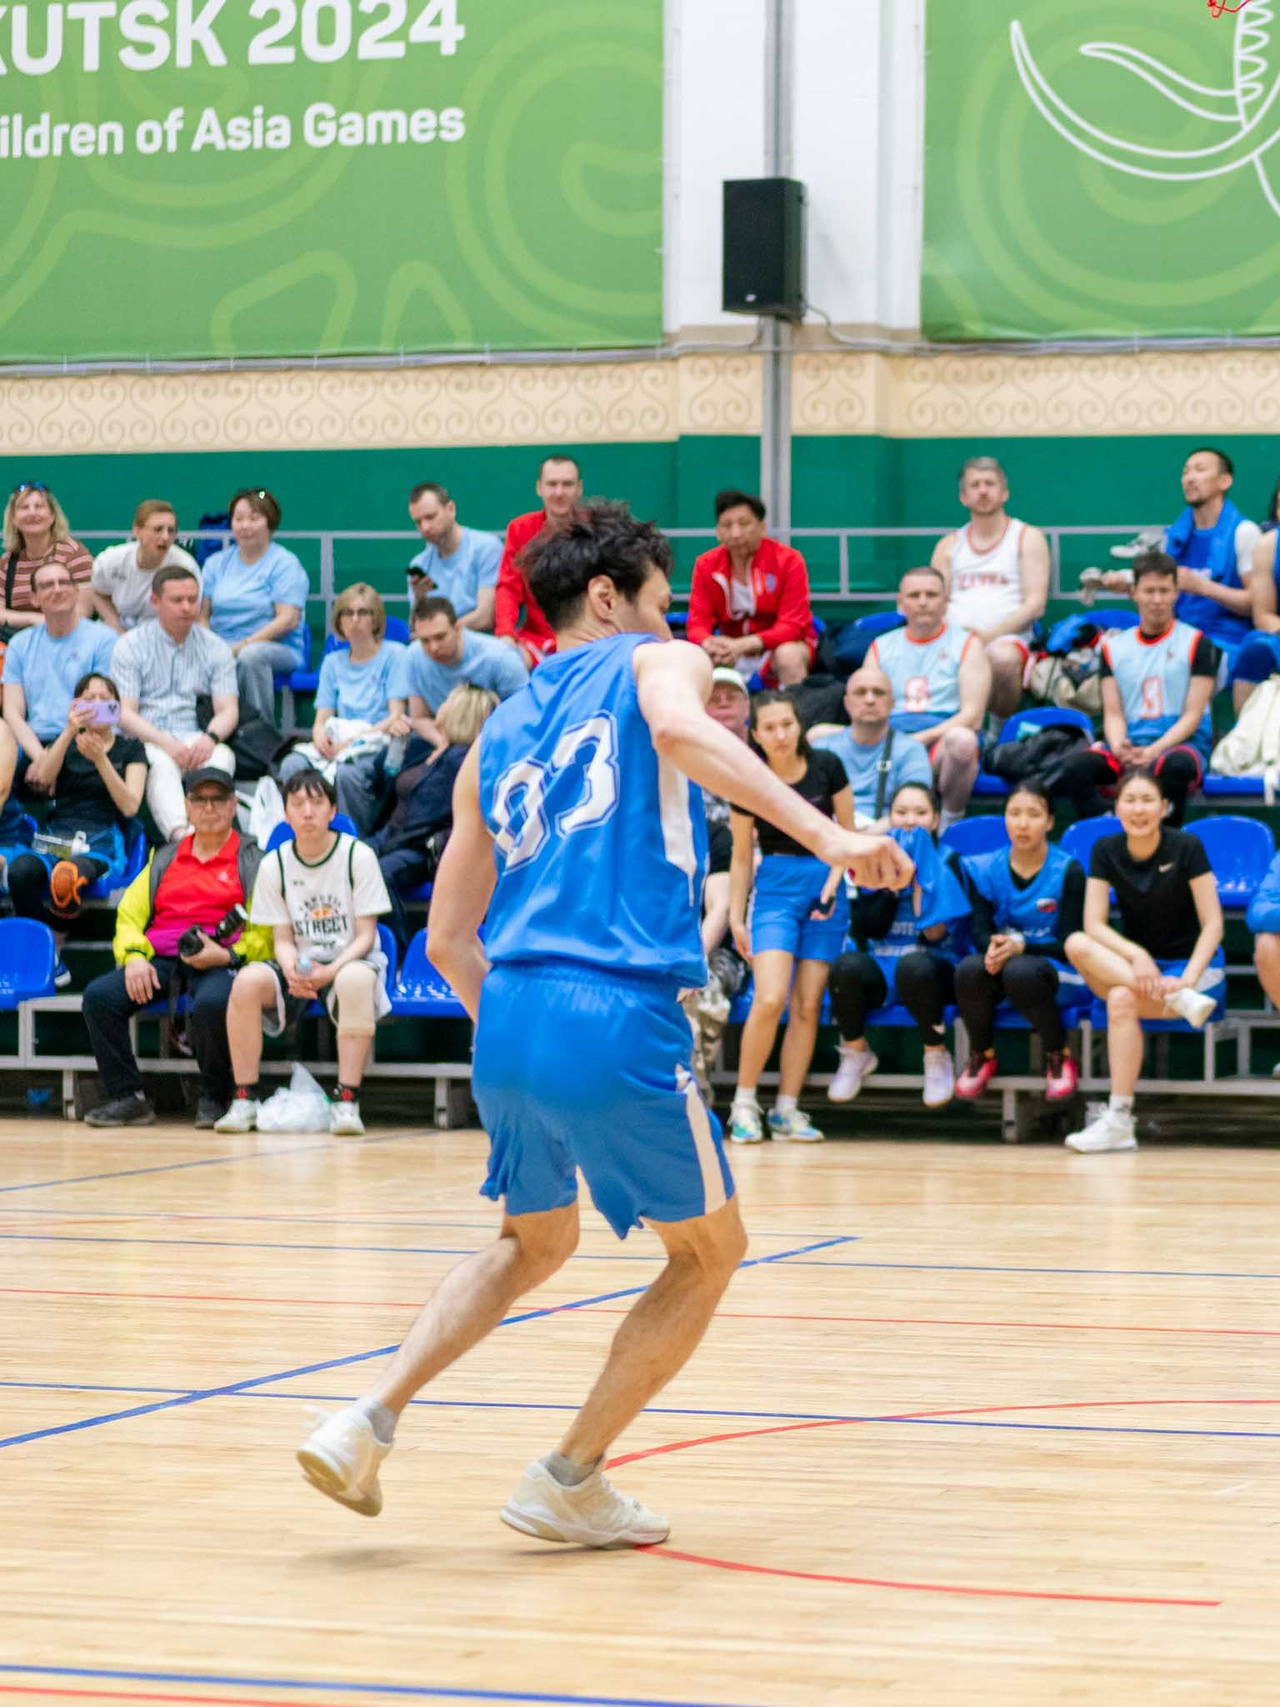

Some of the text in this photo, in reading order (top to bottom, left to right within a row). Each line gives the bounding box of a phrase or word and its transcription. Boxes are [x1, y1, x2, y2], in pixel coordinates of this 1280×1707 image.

[0, 0, 466, 76] UTSK 2024
[135, 107, 184, 155] of
[190, 105, 291, 152] Asia
[303, 101, 466, 147] Games
